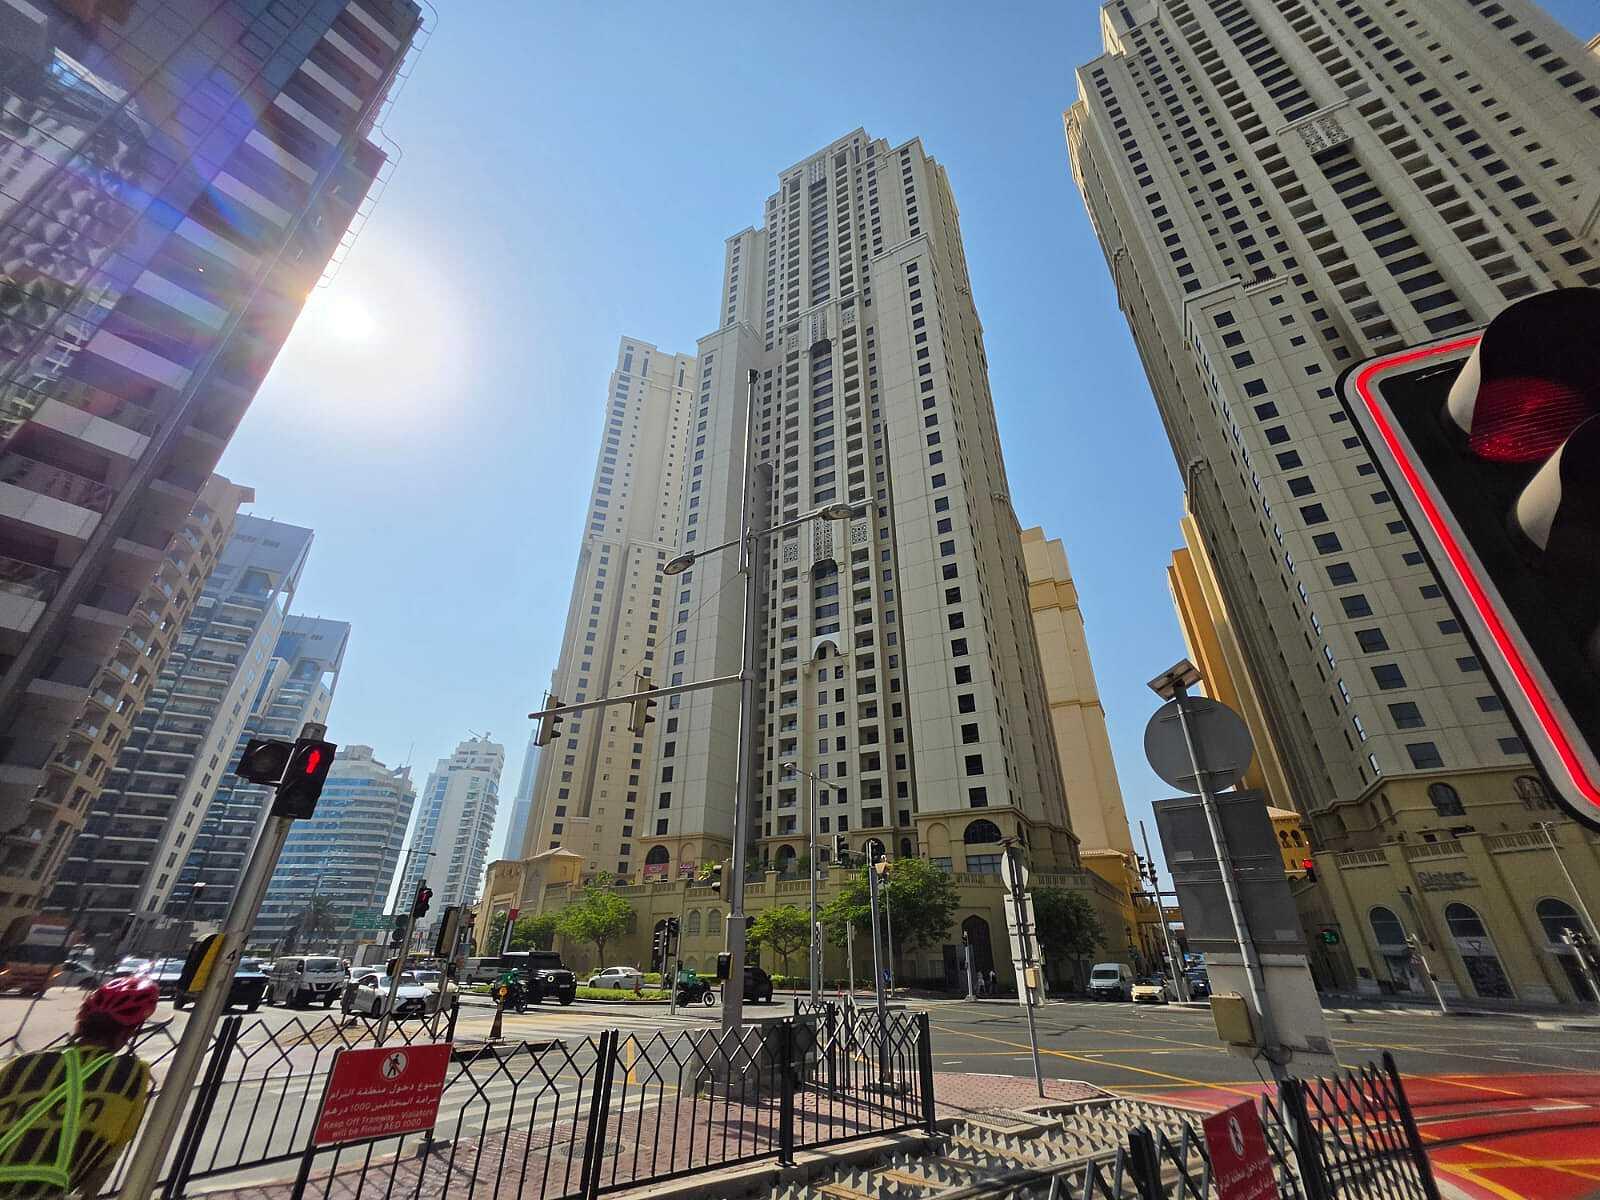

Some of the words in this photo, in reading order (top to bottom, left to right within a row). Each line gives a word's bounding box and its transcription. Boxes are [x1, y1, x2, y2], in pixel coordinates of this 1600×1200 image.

[356, 1087, 385, 1096] منطقة
[351, 1103, 371, 1113] 1000
[323, 1120, 344, 1129] Keep
[346, 1116, 359, 1127] Off
[360, 1114, 395, 1125] Tramway
[384, 1121, 401, 1130] AED
